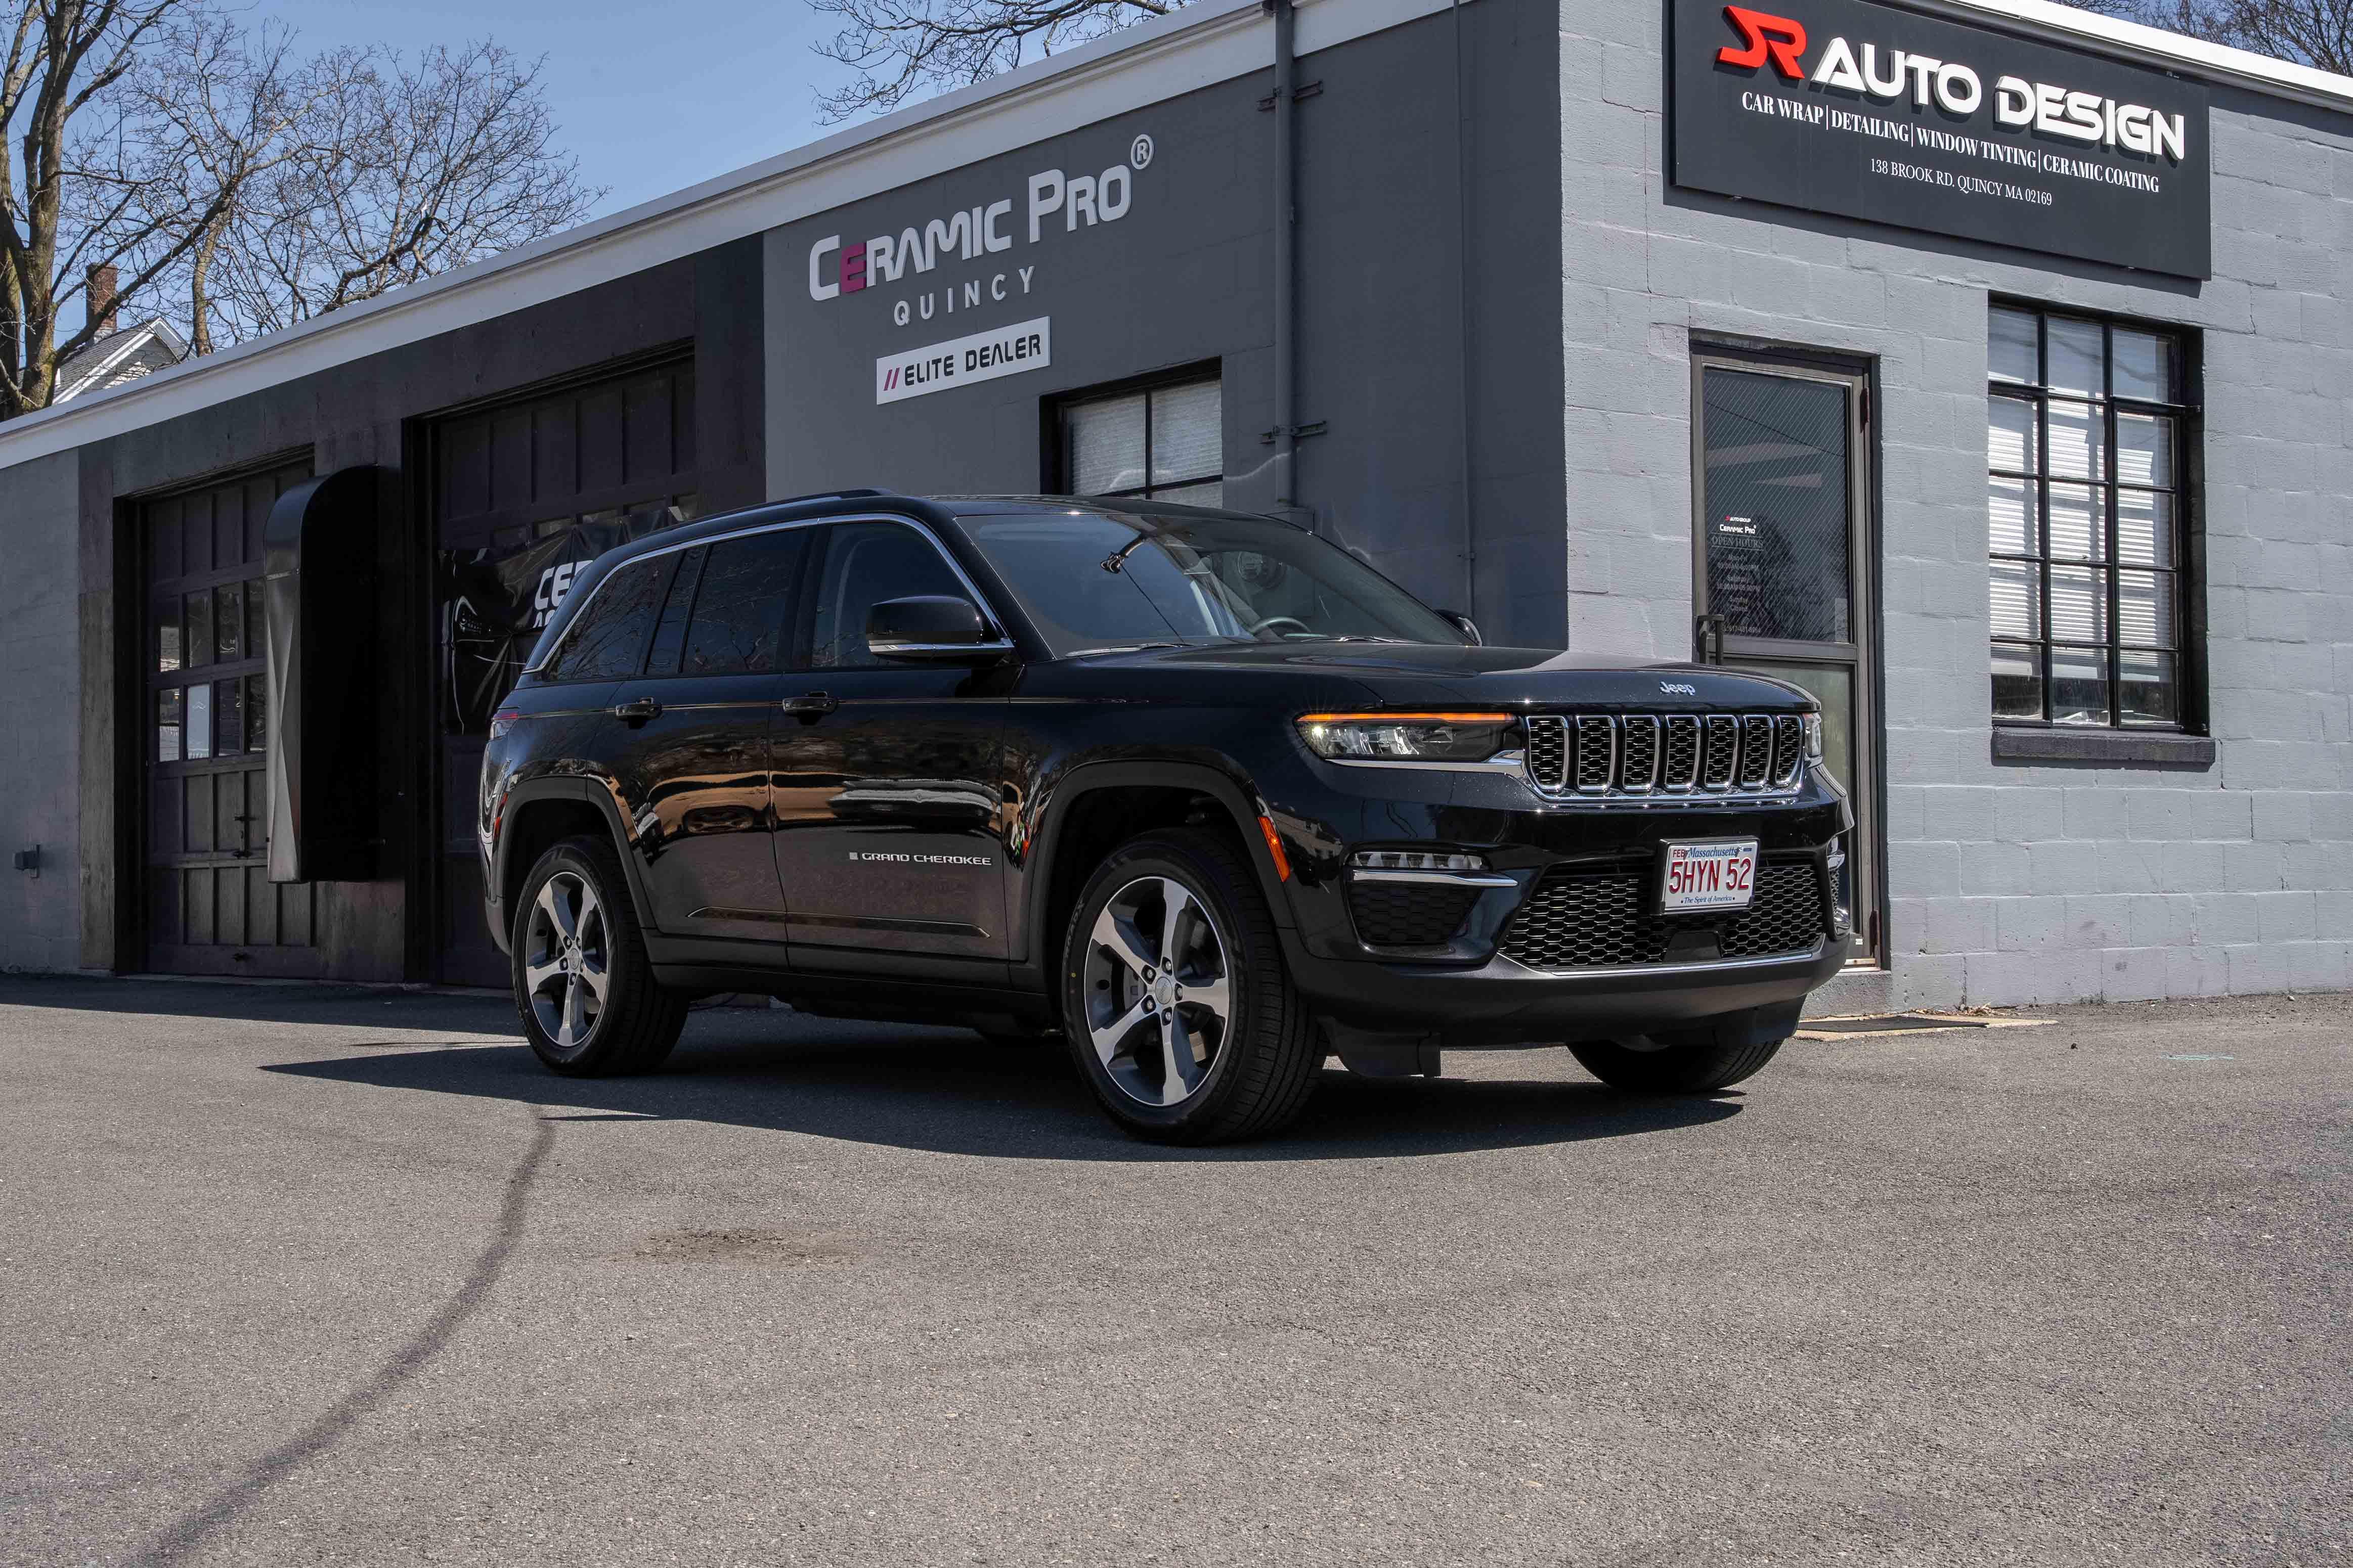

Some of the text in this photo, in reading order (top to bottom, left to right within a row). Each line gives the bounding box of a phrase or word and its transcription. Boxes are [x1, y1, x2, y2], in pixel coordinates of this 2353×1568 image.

[1811, 37, 1982, 114] AUTO
[1994, 75, 2185, 161] DESIGN
[1741, 92, 2160, 194] CAR WRAP DETAILING WINDOW TINTING CERAMIC COATING
[1871, 158, 2053, 206] 138 BROOK RD. QUINCY MA 02169
[809, 198, 1013, 302] CERAMIC
[893, 265, 1035, 326] QUINCY
[965, 333, 1041, 373] DEALER
[1720, 524, 1744, 533] CERAMIC
[1660, 681, 1695, 696] Jeep
[861, 853, 992, 866] GRAND CHEROKEE
[1672, 849, 1686, 858] FEB
[1688, 846, 1738, 858] Massachusetts
[1669, 857, 1753, 894] 5HYN 52
[1694, 896, 1707, 905] Spirit
